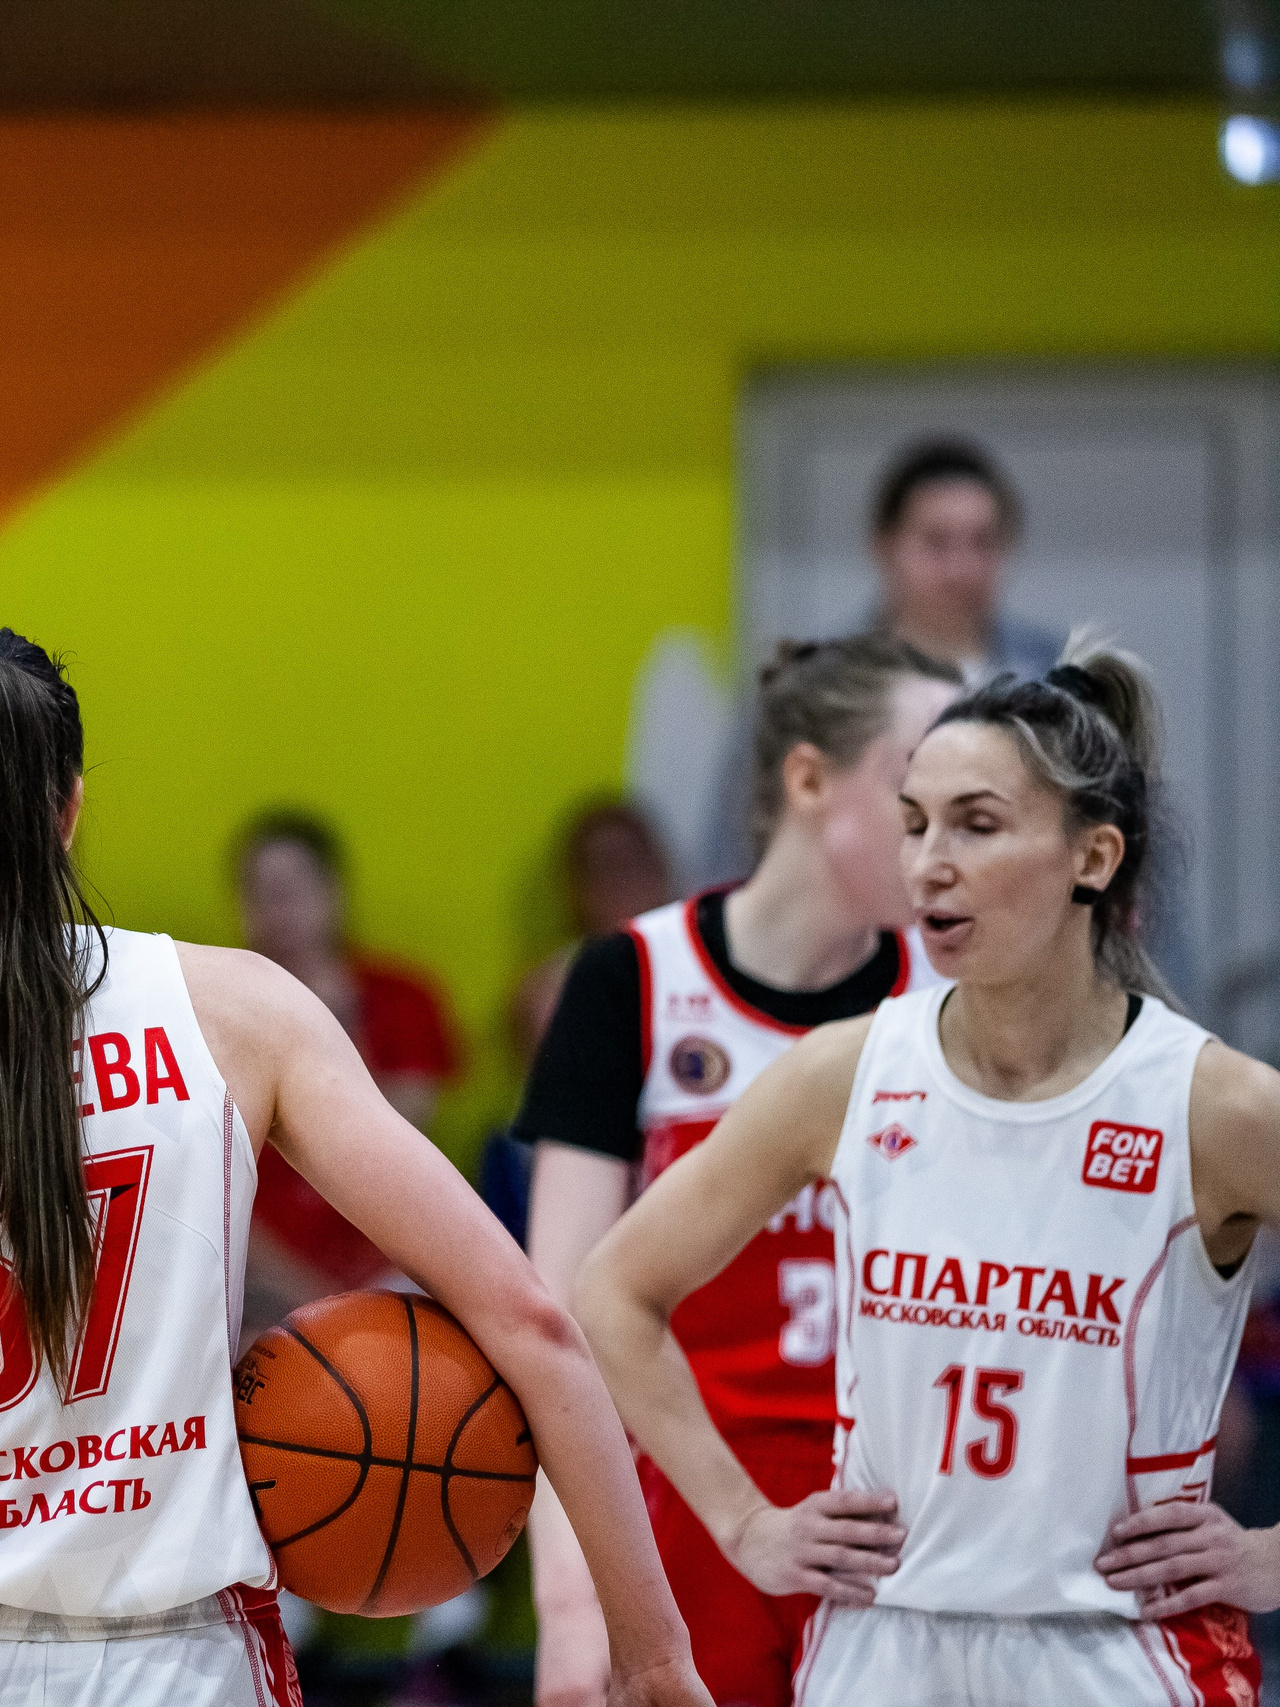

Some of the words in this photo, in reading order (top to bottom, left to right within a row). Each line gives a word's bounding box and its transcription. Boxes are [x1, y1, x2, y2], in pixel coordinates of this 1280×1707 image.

[1090, 1127, 1159, 1158] FON
[1086, 1152, 1155, 1185] BET
[861, 1248, 1127, 1326] СПАРТАК
[858, 1298, 1007, 1332] МОСКОВСКАЯ
[1017, 1315, 1122, 1348] ОБЛАСТЬ
[931, 1362, 1025, 1481] 15
